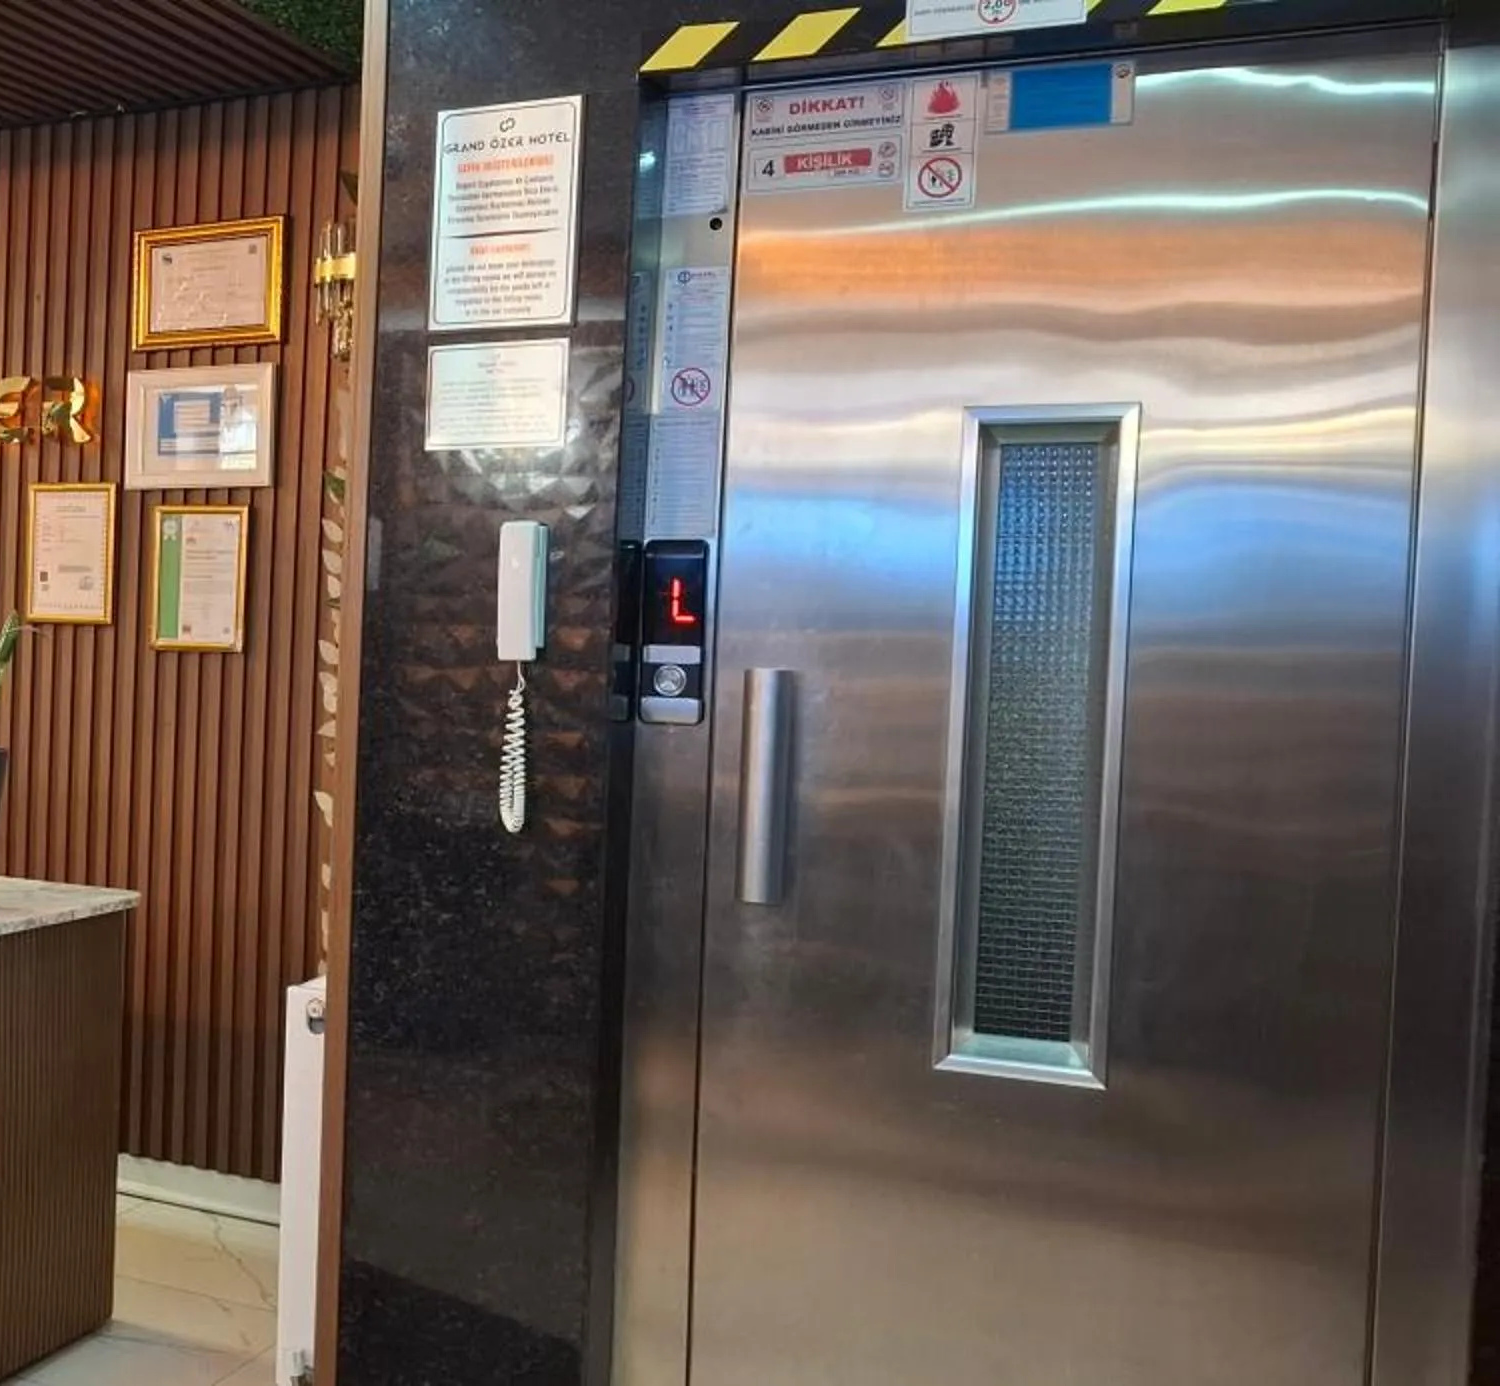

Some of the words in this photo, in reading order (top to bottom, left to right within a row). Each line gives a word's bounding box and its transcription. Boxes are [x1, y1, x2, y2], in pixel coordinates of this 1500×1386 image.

[529, 131, 571, 145] HOTEL
[761, 159, 775, 176] 4
[672, 576, 696, 622] L
